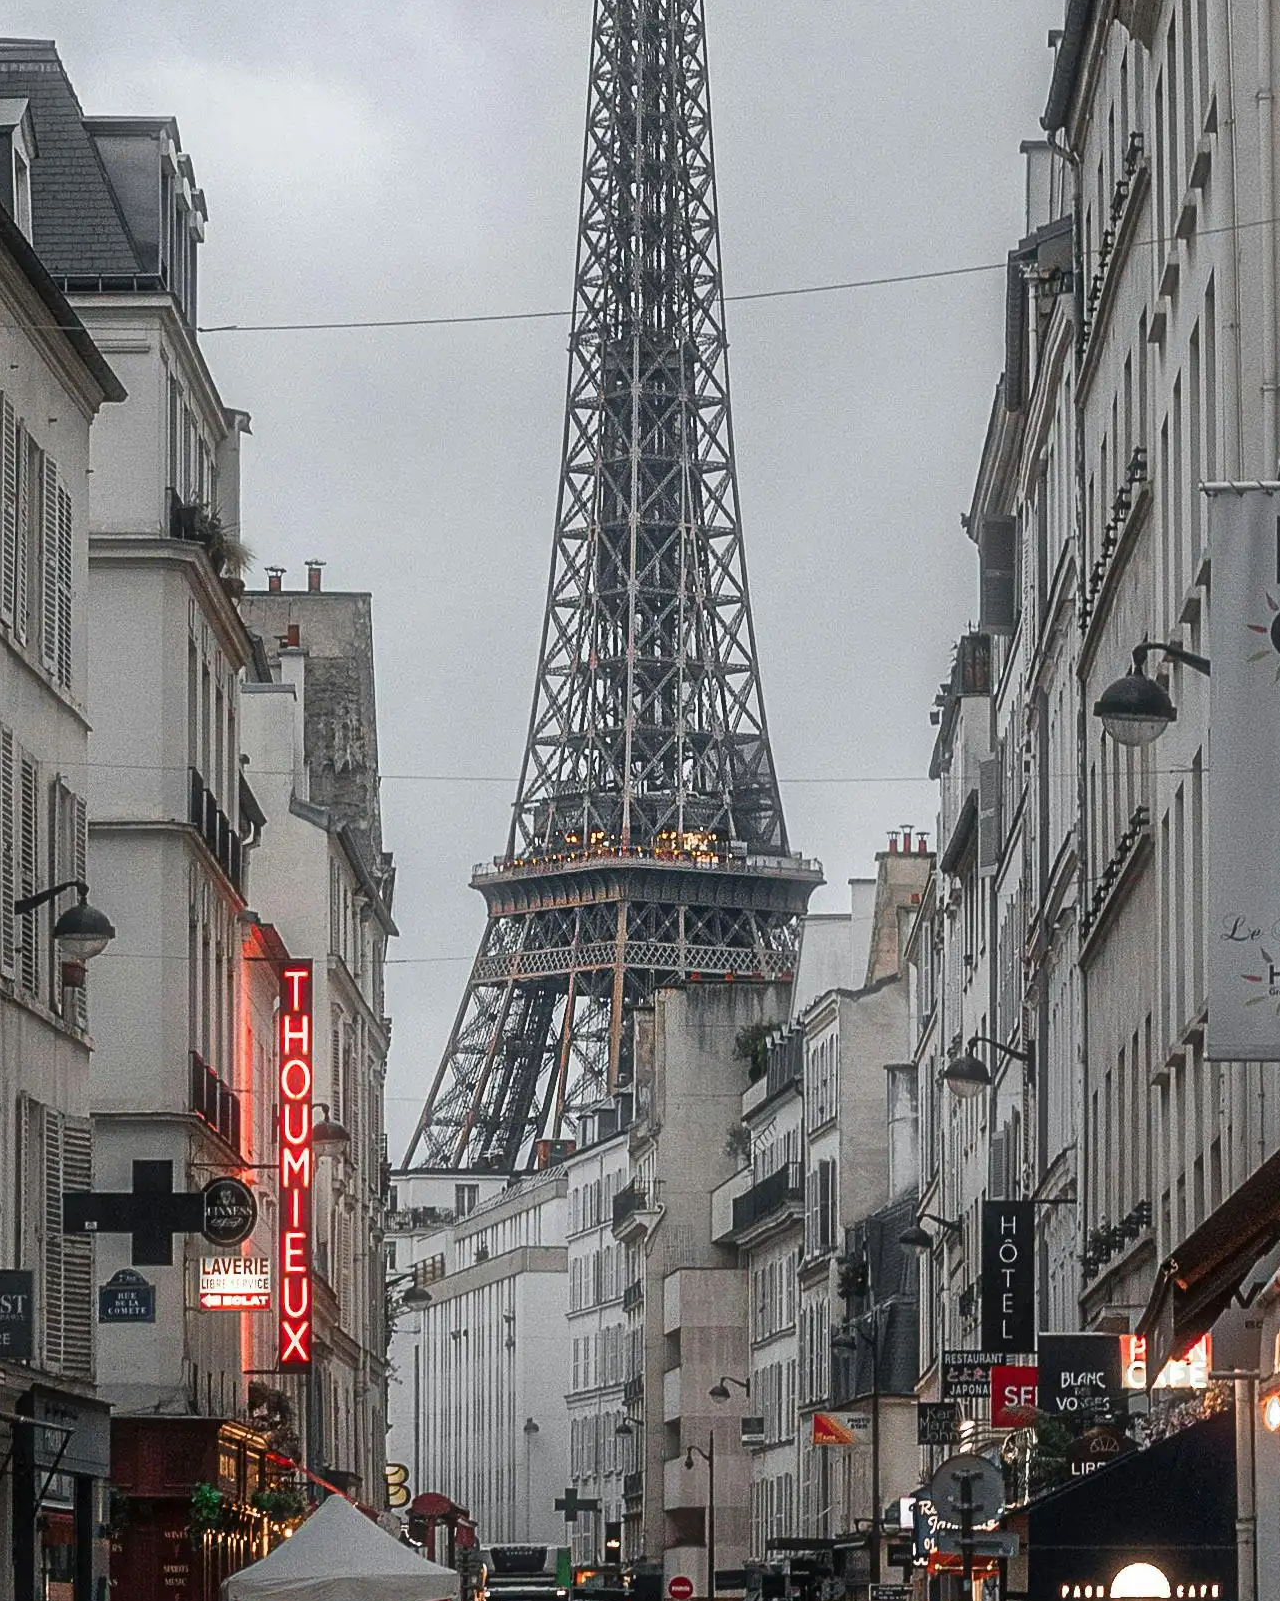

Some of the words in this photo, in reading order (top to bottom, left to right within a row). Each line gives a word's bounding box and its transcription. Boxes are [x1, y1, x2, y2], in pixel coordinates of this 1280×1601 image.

[1220, 913, 1262, 942] Le
[280, 970, 312, 1362] THOUMIEUX
[201, 1257, 269, 1275] LAVERIE
[201, 1278, 227, 1290] LIBRE
[999, 1215, 1018, 1340] HÔTEL
[944, 1353, 1004, 1365] RESTAURANT
[1060, 1371, 1107, 1389] BLANC
